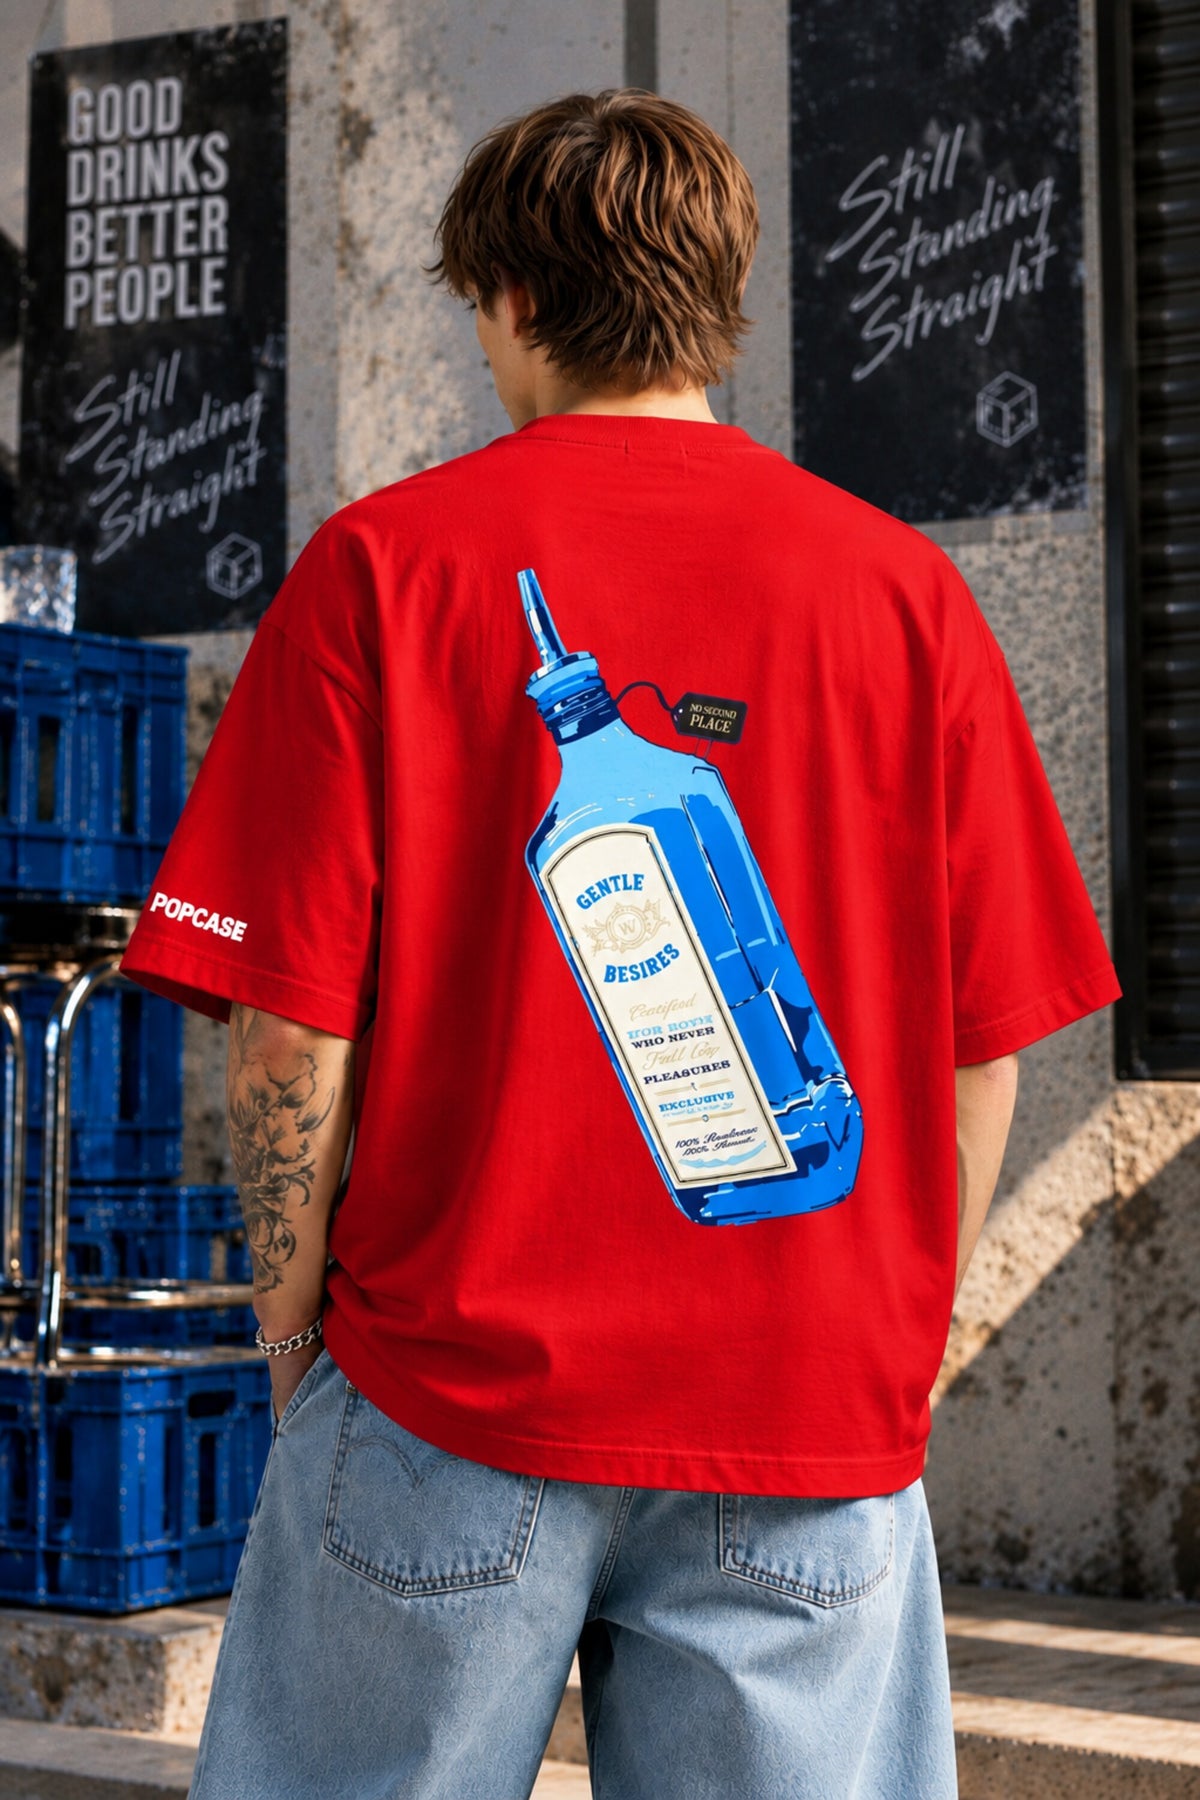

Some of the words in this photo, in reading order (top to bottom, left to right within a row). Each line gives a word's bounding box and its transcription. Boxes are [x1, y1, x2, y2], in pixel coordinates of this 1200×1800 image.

[67, 76, 183, 145] GOOD
[67, 131, 230, 207] DRINKS
[825, 124, 965, 263] Still
[66, 195, 229, 269] BETTER
[849, 176, 1060, 312] Standing
[65, 257, 227, 330] PEOPLE
[850, 234, 1059, 382] Straight
[65, 349, 182, 464] Still
[88, 391, 265, 508] Standing
[92, 441, 268, 566] Straight
[689, 703, 703, 713] NO
[689, 713, 733, 734] PLACE
[149, 891, 248, 943] POPCASE
[576, 873, 645, 910] GENTLE
[603, 943, 680, 983] BESIRES
[631, 1037, 665, 1050] WHO
[667, 1026, 716, 1043] NEVER
[643, 1059, 731, 1085] PLEASURES
[674, 1137, 700, 1149] 100%
